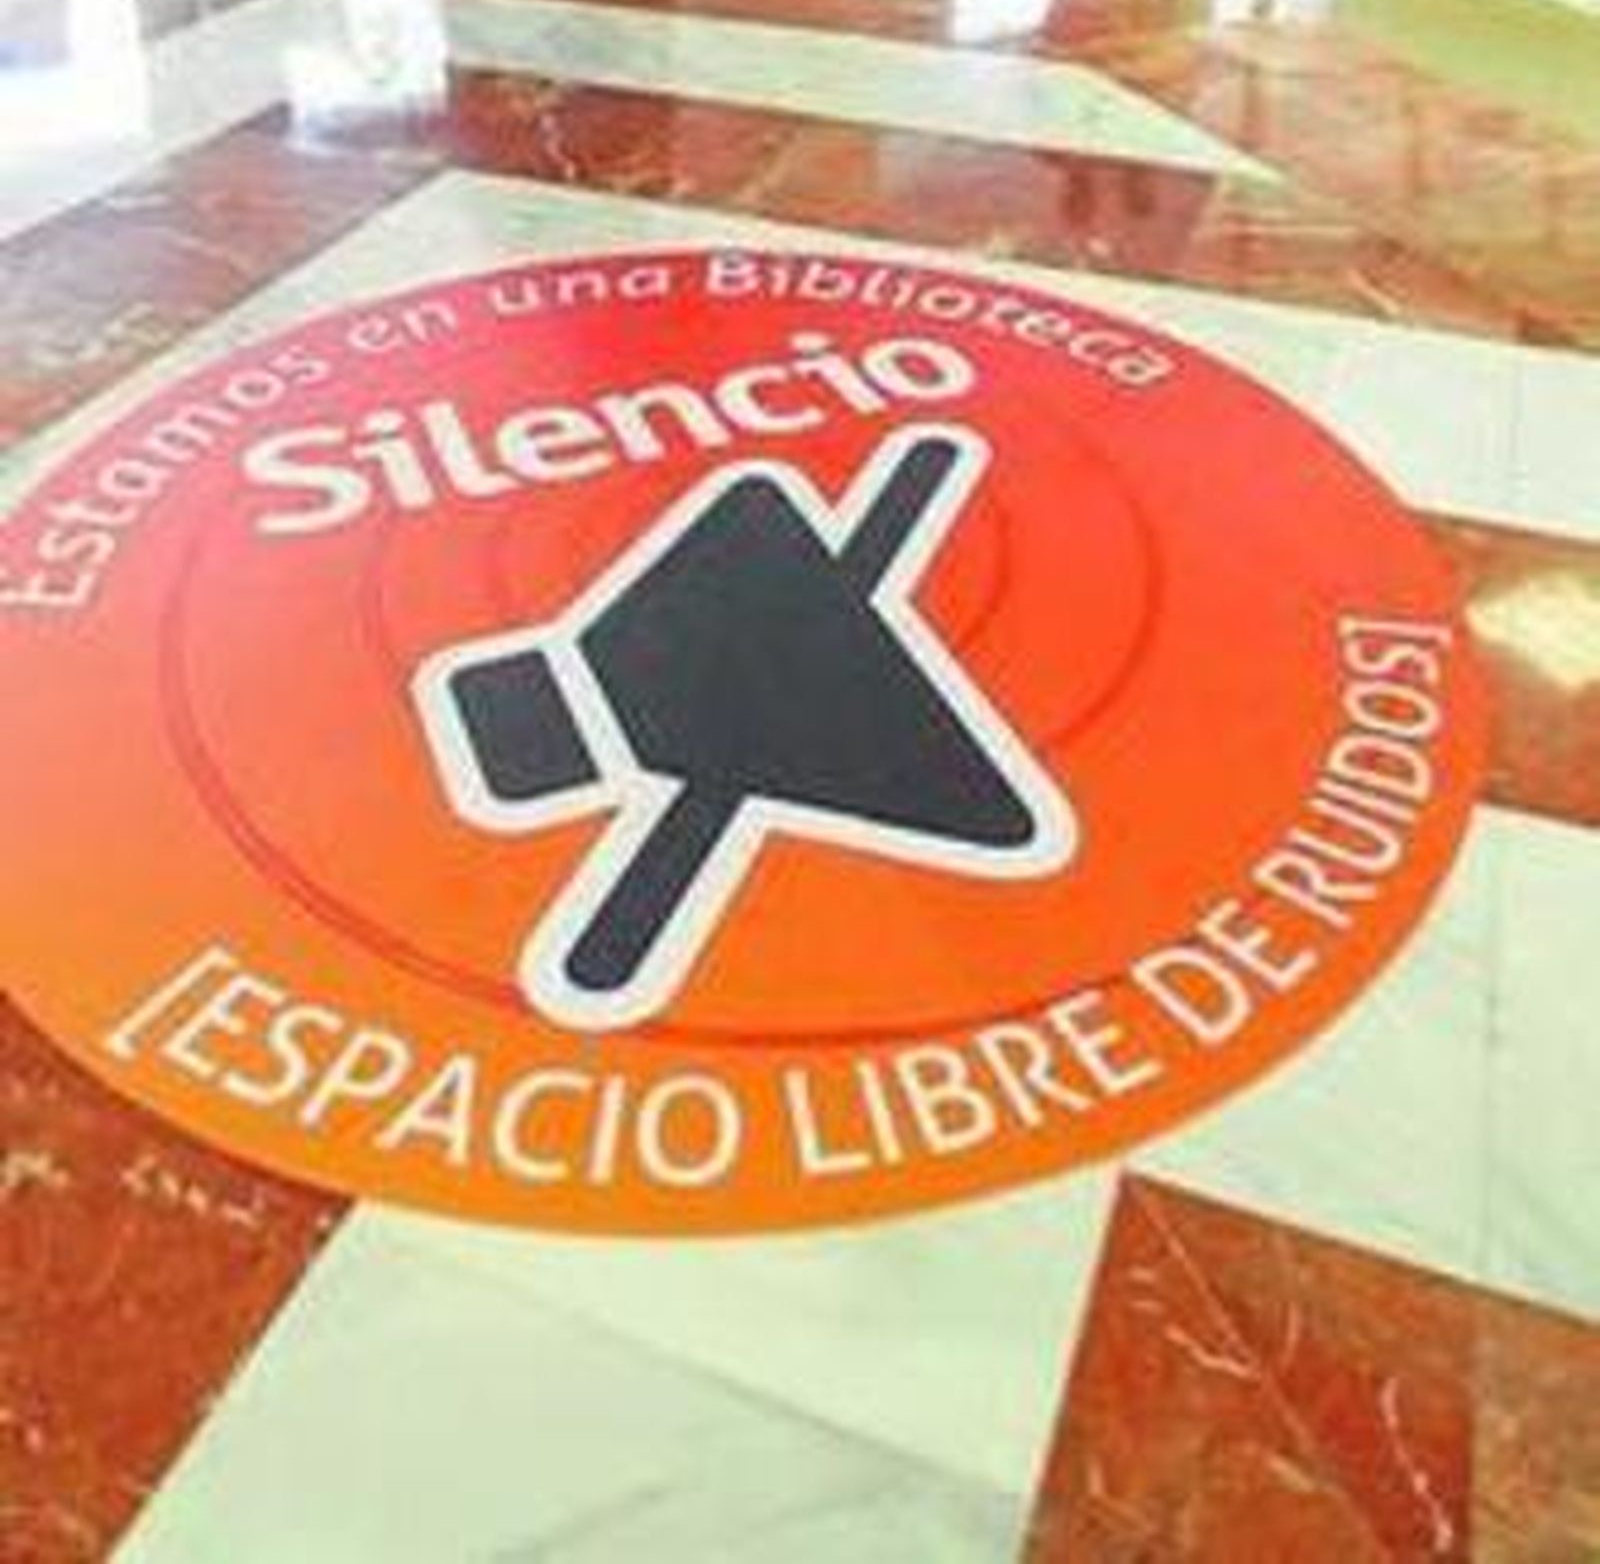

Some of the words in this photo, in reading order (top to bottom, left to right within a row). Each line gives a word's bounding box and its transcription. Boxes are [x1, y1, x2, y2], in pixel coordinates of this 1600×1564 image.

[0, 343, 331, 610] Estamos
[347, 299, 459, 351] en
[489, 264, 671, 314] una
[706, 251, 1177, 388] Biblioteca
[239, 331, 977, 536] Silencio
[105, 944, 742, 1186] [ESPACIO
[785, 988, 1165, 1176] LIBRE
[1129, 898, 1318, 1045] DE
[1252, 615, 1454, 929] RUIDOS]
